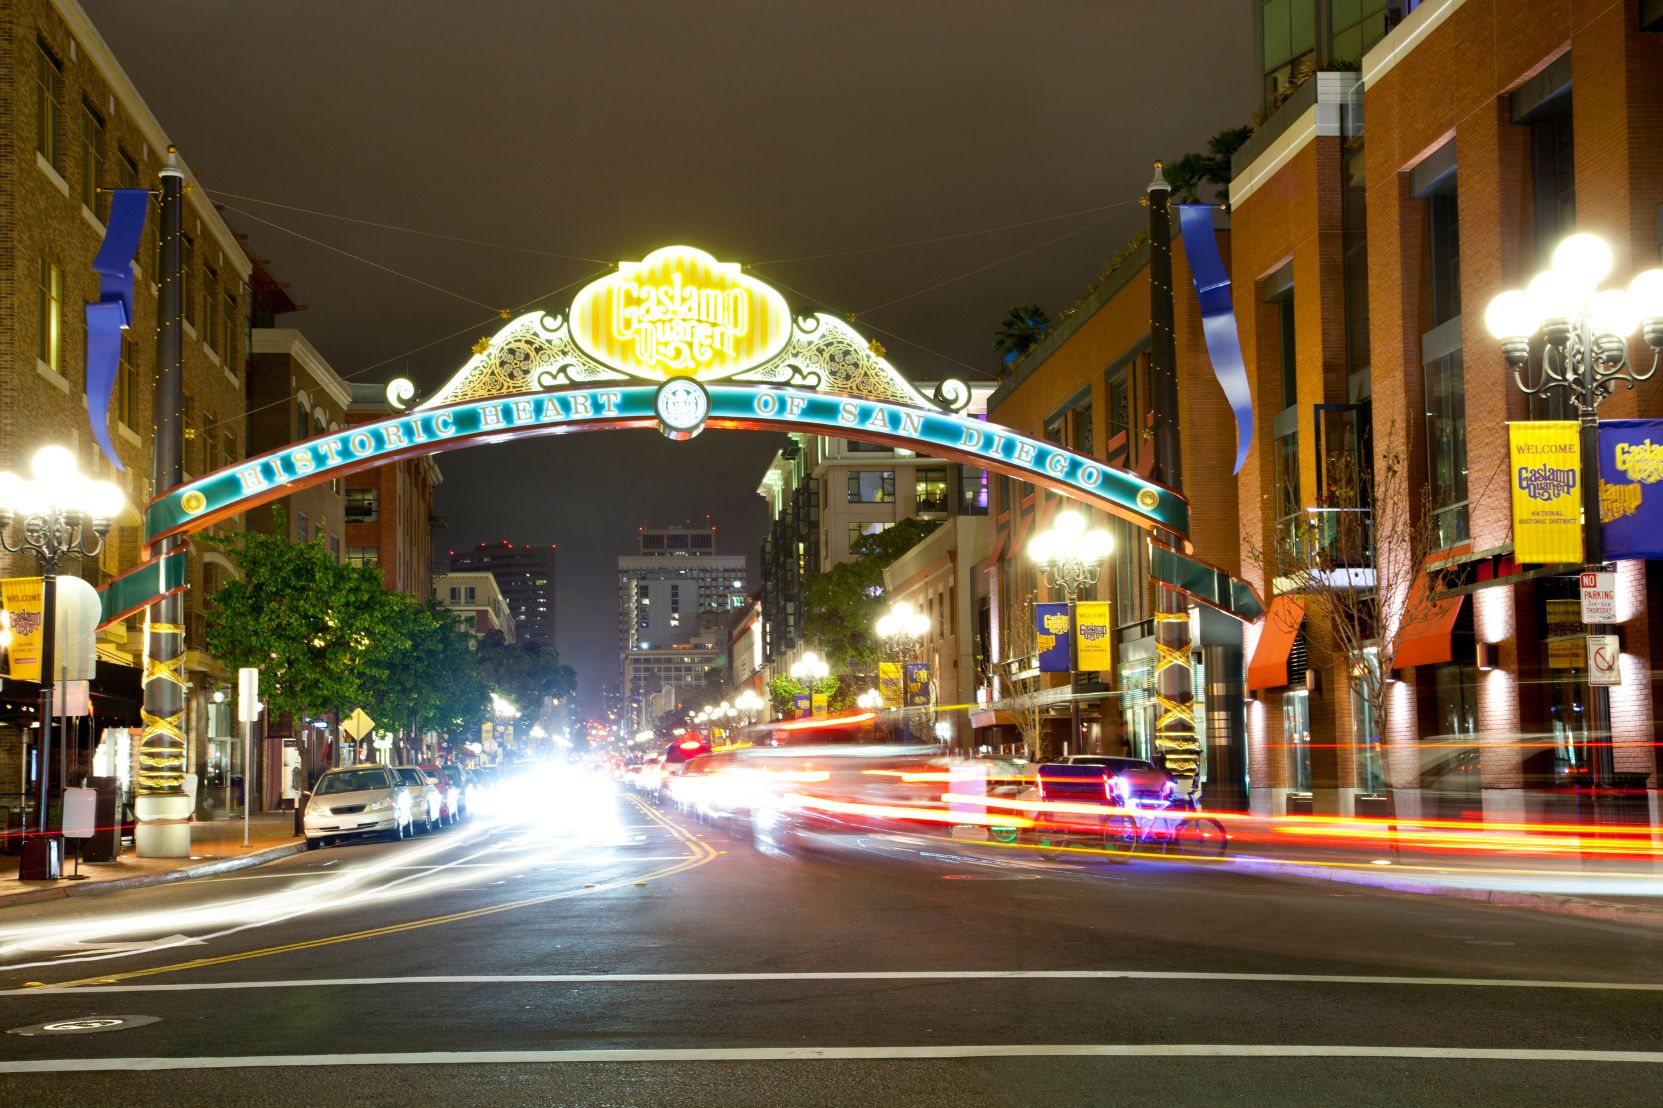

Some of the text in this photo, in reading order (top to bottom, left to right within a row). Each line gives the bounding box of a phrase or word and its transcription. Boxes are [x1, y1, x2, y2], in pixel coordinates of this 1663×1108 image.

[613, 272, 748, 341] Gaslamp
[635, 319, 736, 369] Quarter
[237, 412, 456, 492] HISTORIC
[479, 392, 620, 427] HEART
[756, 393, 806, 417] OF
[840, 402, 925, 435] SAN
[960, 426, 1101, 487] DIEGO
[1516, 443, 1577, 455] WELCOME
[1518, 463, 1577, 491] Gaslamp
[1528, 482, 1571, 502] Quarter
[1583, 575, 1595, 587] NO
[7, 594, 41, 602] WELCOME
[1584, 591, 1614, 600] PARKING
[1586, 607, 1613, 615] THURSDAY
